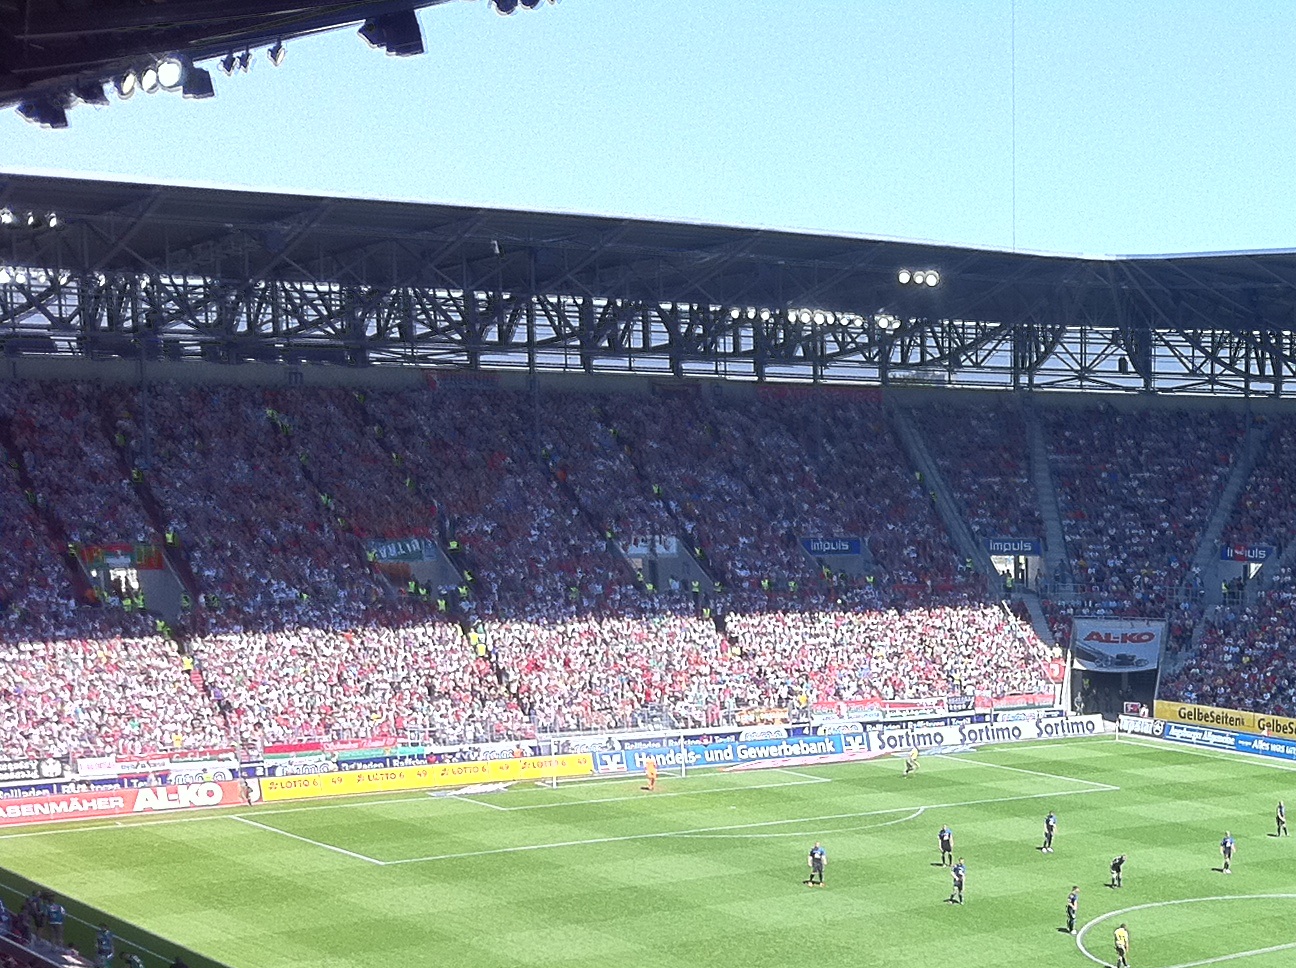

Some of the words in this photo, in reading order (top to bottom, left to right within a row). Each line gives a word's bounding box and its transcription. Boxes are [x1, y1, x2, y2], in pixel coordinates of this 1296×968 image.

[810, 538, 849, 552] impuls
[989, 539, 1032, 553] impuls
[1083, 631, 1156, 643] AL-KO
[1178, 706, 1241, 727] GelbeSeiten
[877, 731, 944, 751] Sortimo
[958, 724, 1022, 746] Sortimo
[1035, 718, 1096, 738] Sortimo
[704, 744, 734, 763] und
[736, 737, 836, 761] Gewerbebank
[1251, 738, 1271, 752] Alles
[1270, 743, 1286, 754] was
[281, 779, 310, 789] LOTTO
[132, 781, 224, 812] AL-KO
